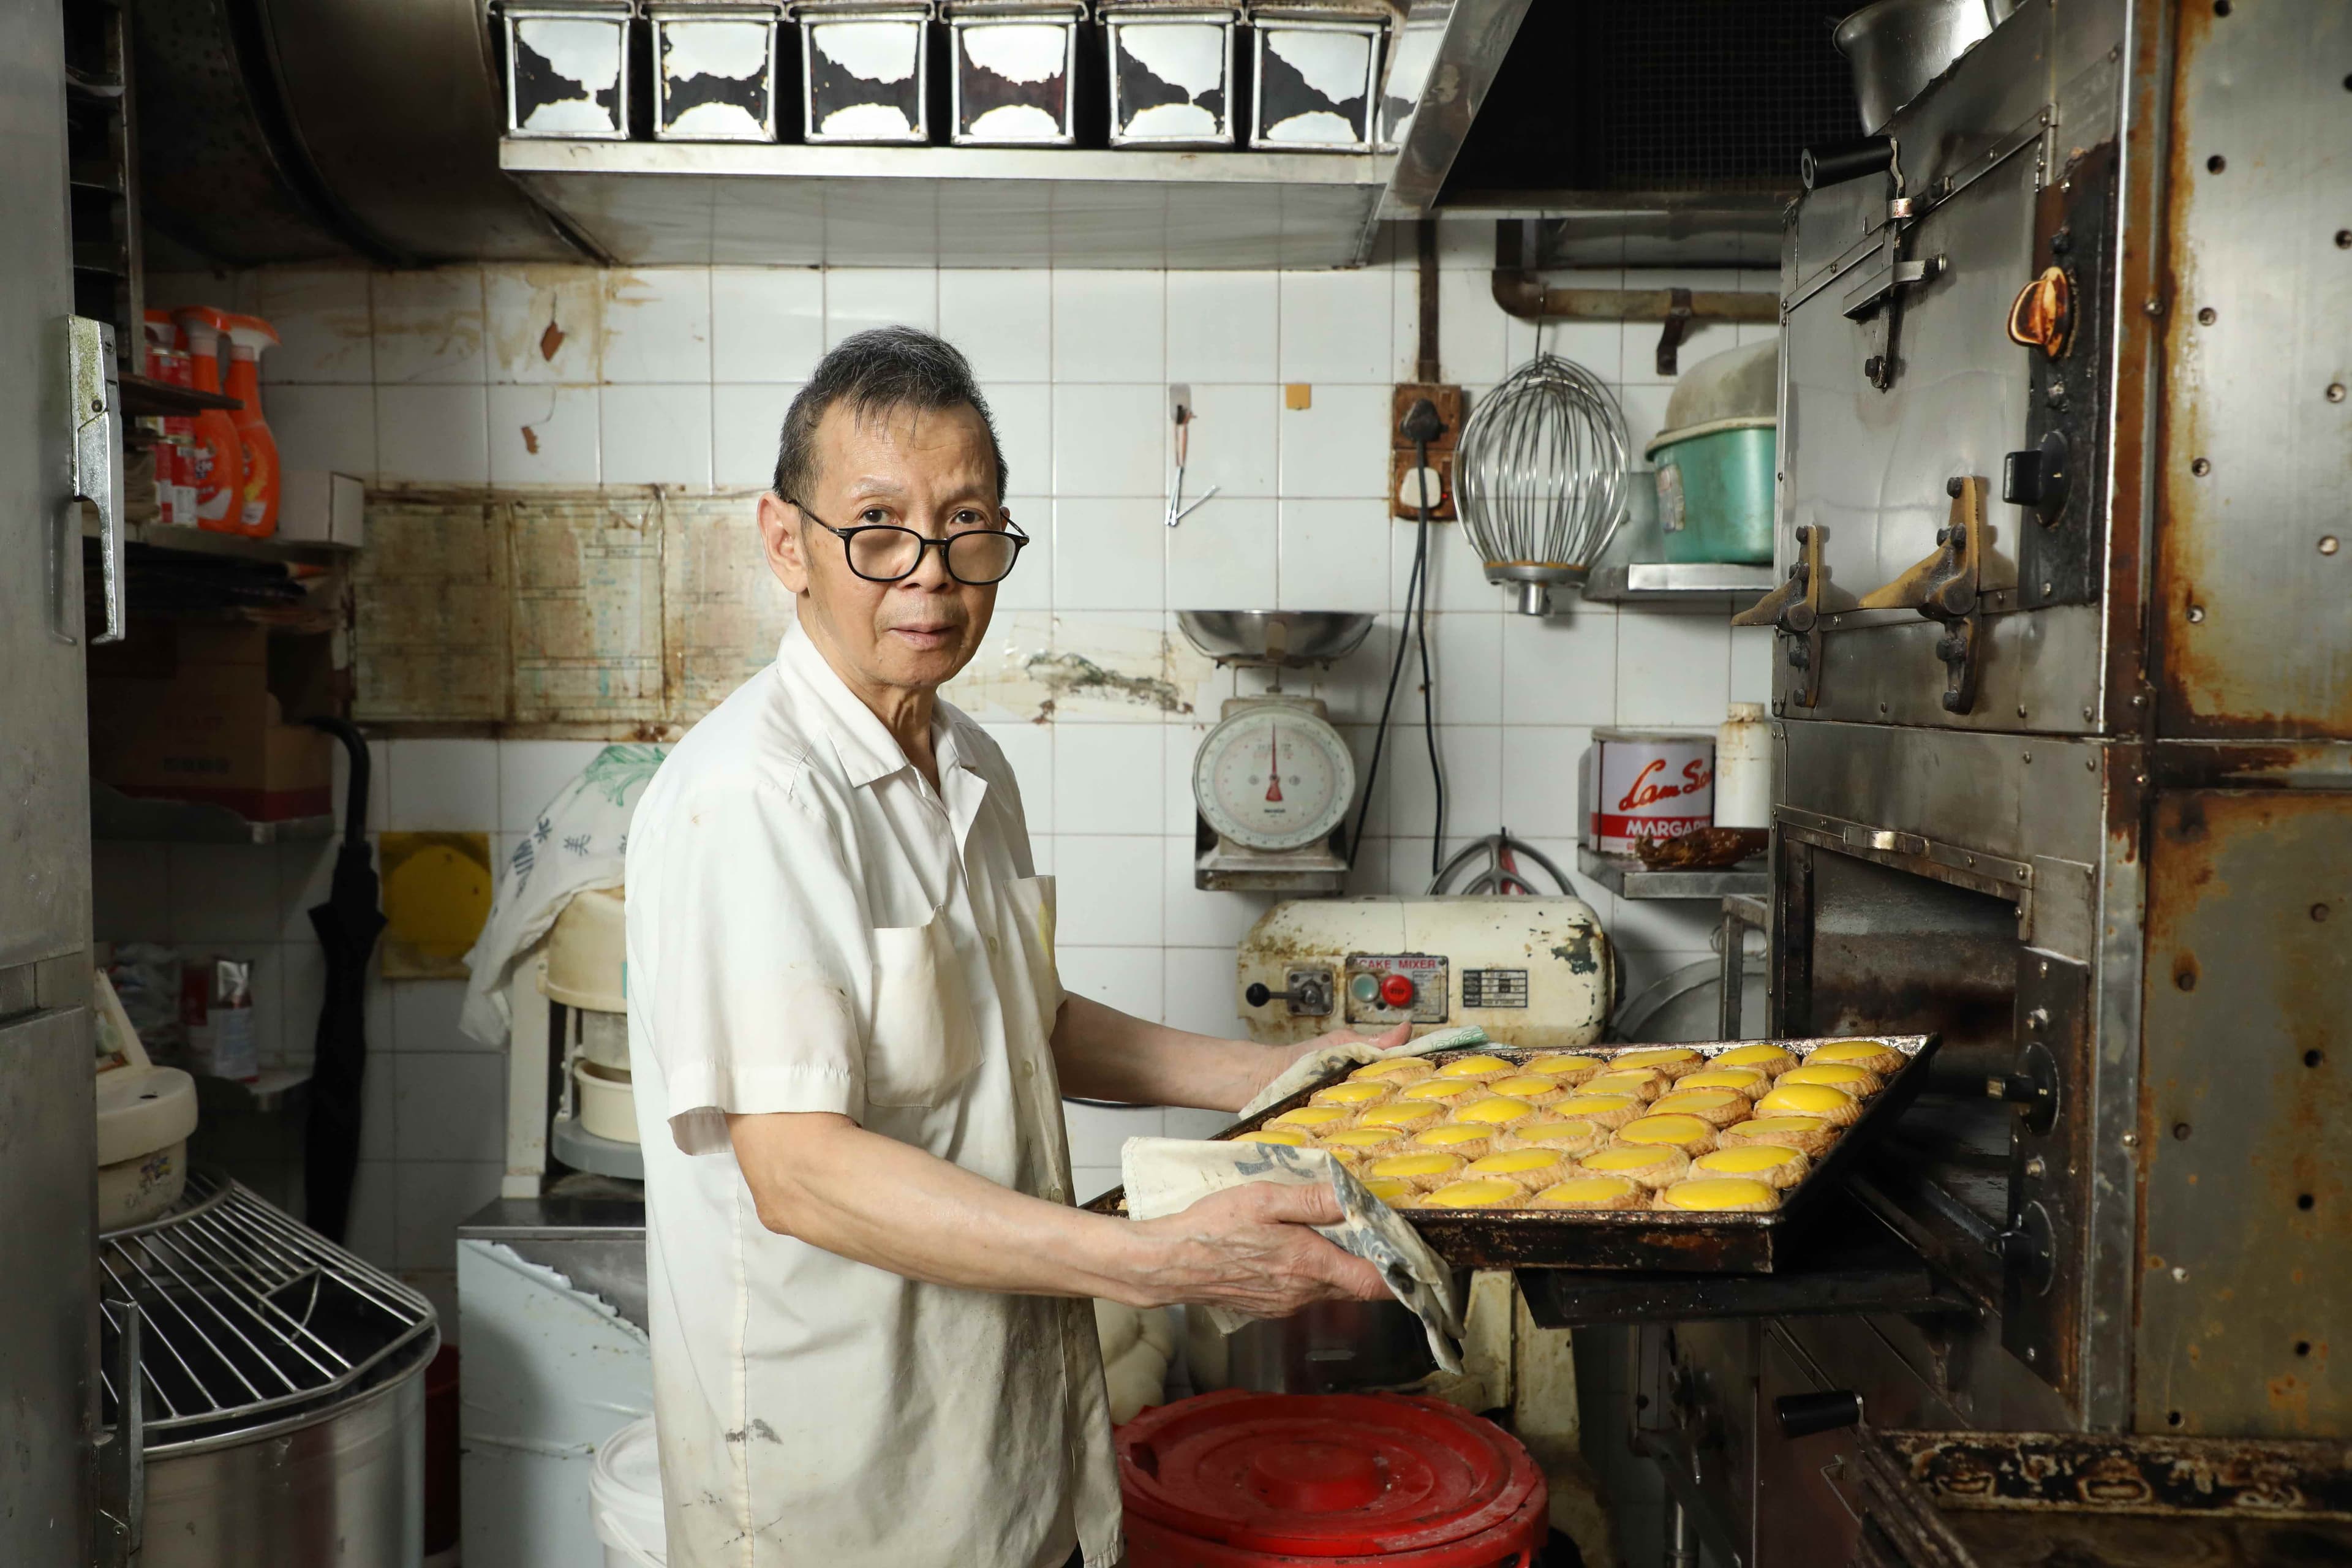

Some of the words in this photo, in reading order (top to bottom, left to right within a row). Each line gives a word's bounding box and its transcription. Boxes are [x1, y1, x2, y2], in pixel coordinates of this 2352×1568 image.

[1618, 759, 1681, 812] Lam
[1359, 959, 1392, 970] CAKE
[1398, 959, 1436, 969] MIXER
